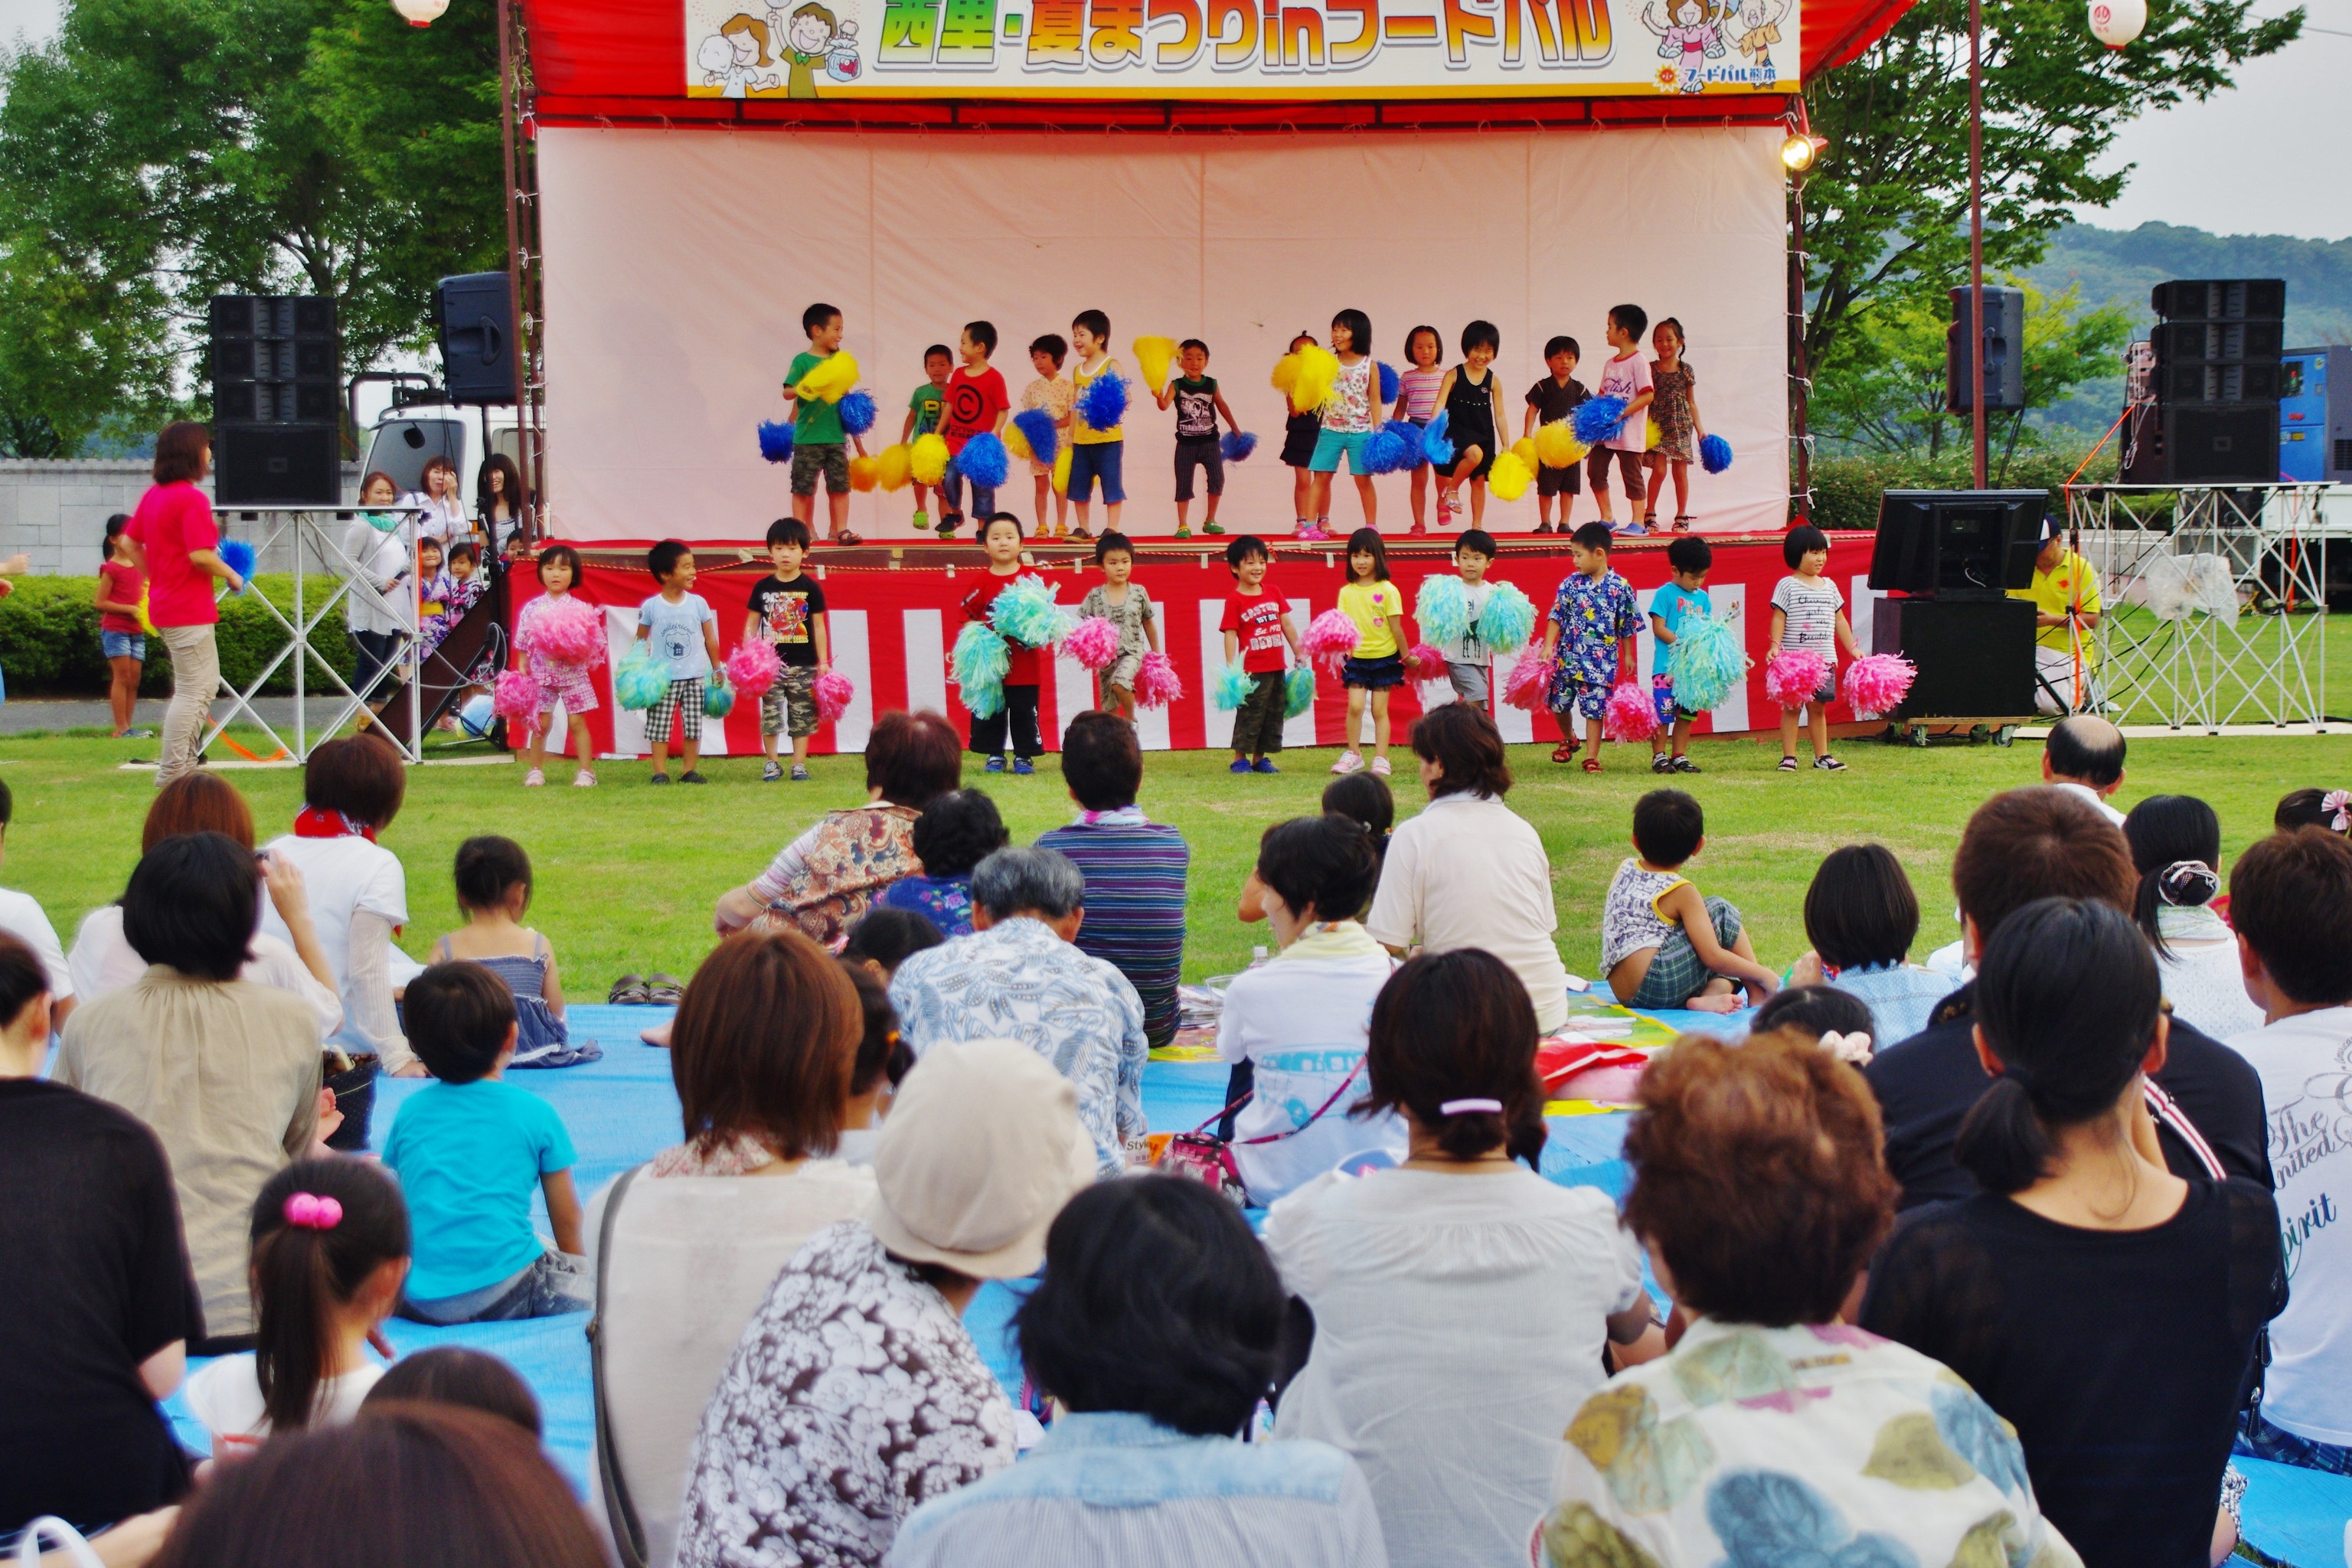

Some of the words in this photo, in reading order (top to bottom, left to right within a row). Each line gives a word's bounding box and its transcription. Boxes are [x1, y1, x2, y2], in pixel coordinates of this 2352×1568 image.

[1684, 64, 1776, 82] フードパル熊本
[2275, 1128, 2336, 1190] nited
[2281, 1192, 2337, 1281] pirit
